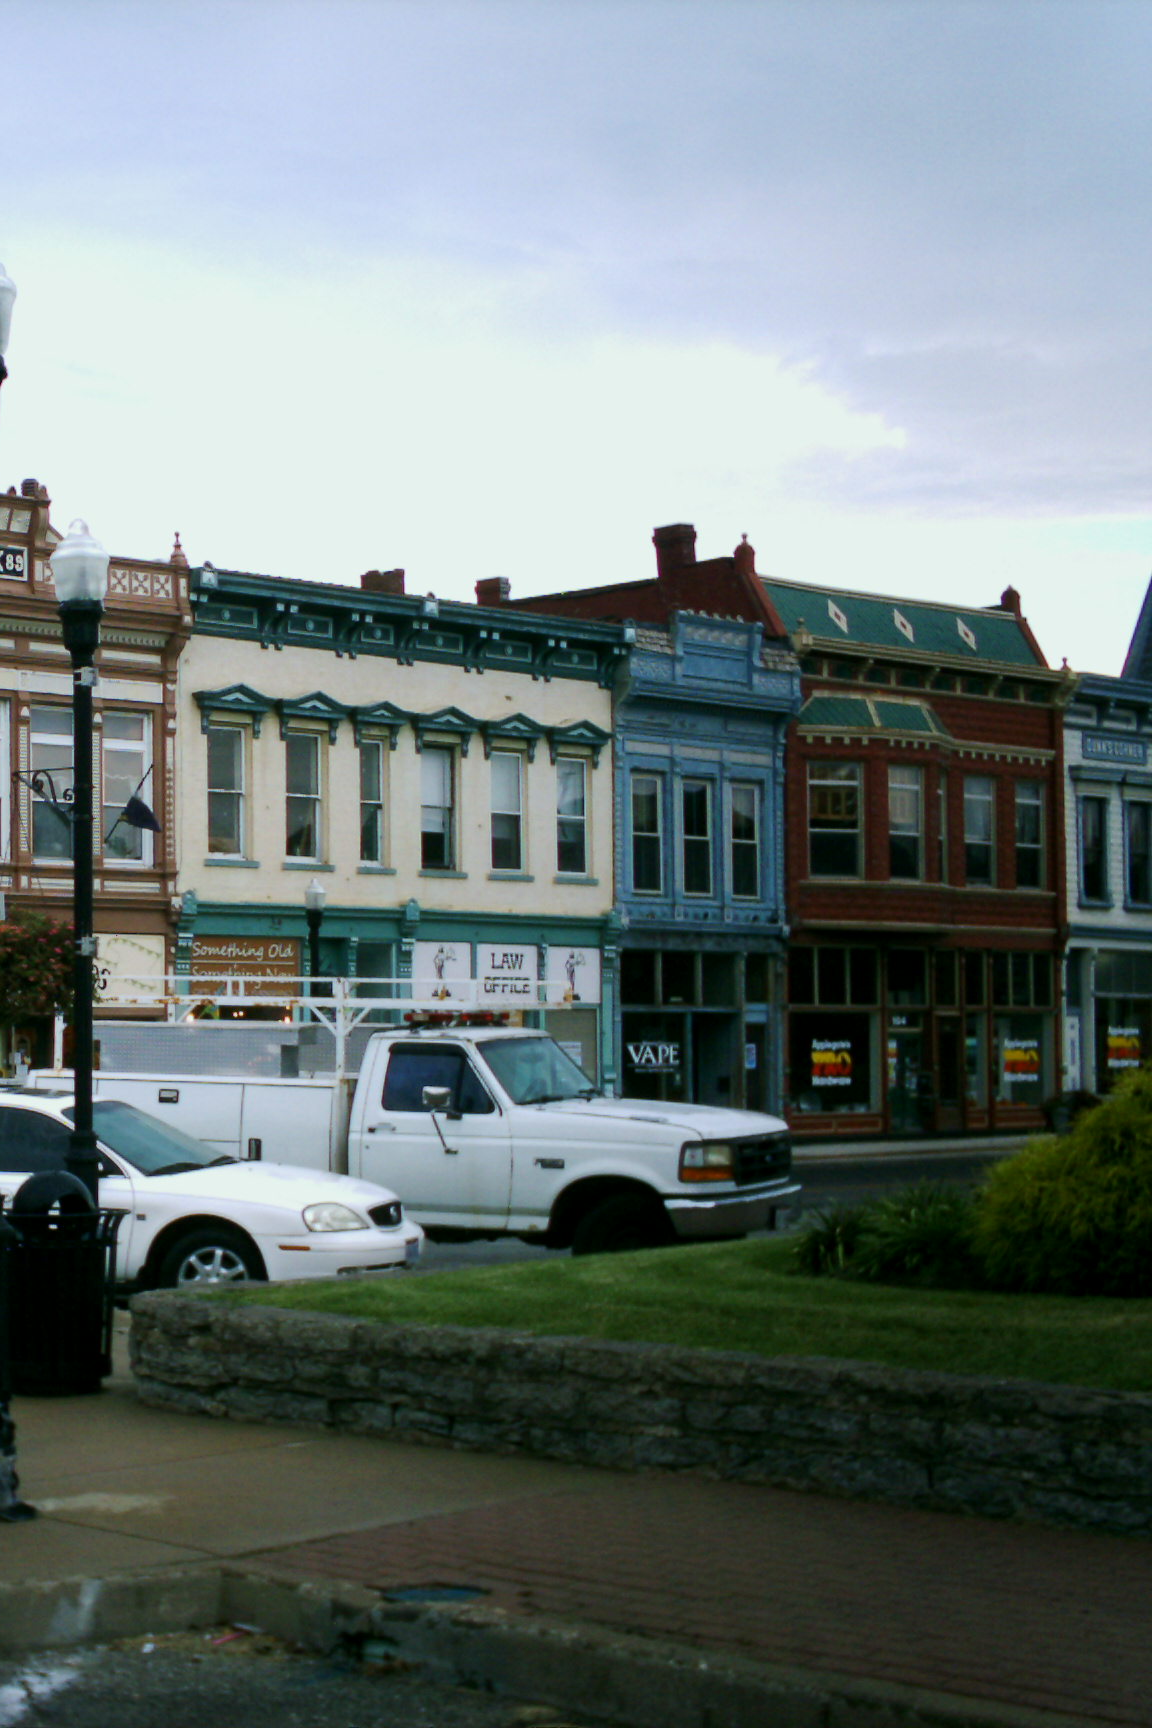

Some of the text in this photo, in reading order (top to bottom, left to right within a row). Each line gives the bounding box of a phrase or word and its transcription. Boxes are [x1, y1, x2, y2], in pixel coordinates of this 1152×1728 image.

[5, 553, 24, 572] 89
[192, 941, 294, 961] Something Old
[491, 952, 524, 970] LAW
[484, 976, 530, 994] OFFICE
[627, 1044, 680, 1065] VAPE
